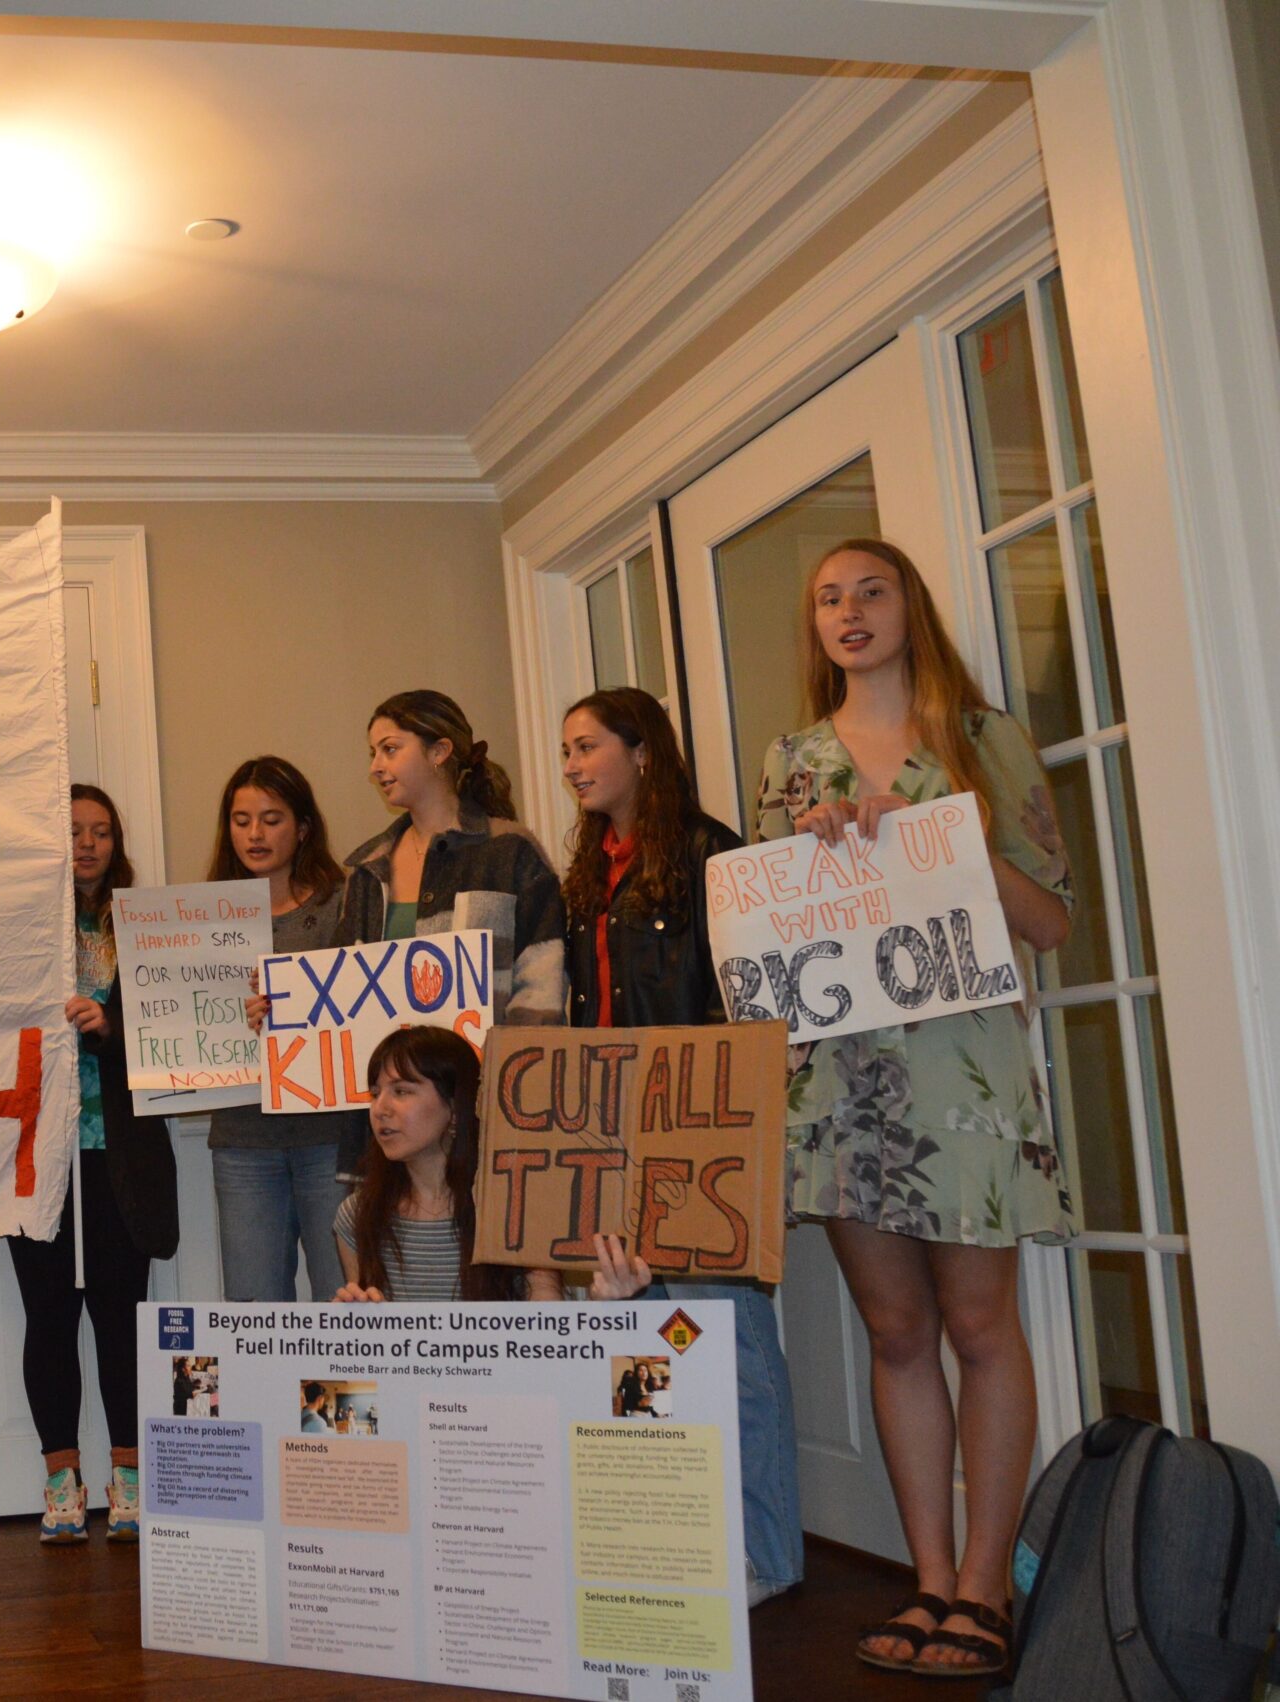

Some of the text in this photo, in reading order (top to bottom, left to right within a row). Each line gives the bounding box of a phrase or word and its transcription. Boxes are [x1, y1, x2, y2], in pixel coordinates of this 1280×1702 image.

[706, 805, 964, 918] BREAK UP
[119, 899, 261, 924] FOSSIL FUEL DIVEST
[770, 887, 892, 944] WITH
[135, 933, 201, 950] HARVARD
[211, 931, 250, 947] SAYS,
[135, 964, 171, 987] OUR
[181, 964, 254, 983] UNIVERSIT
[719, 908, 1018, 1032] BIG OIL
[263, 932, 488, 1031] EXXON
[140, 999, 179, 1018] NEED
[138, 1026, 260, 1068] FREE RESEAR
[498, 1040, 755, 1136] CUT ALL
[492, 1148, 749, 1273] TIES
[208, 1312, 638, 1336] Beyond the Endowment: Uncovering Fossil
[235, 1338, 605, 1364] Fuel Infiltration of Campus Research
[330, 1364, 493, 1378] Phoebe Barr and Becky Schwartz
[428, 1402, 467, 1413] Results
[150, 1424, 245, 1436] What's the problem?
[448, 1423, 456, 1431] at
[457, 1423, 487, 1431] Harvard
[576, 1426, 686, 1440] Recommendations
[285, 1442, 328, 1453] Methods
[151, 1527, 190, 1539] Abstract
[431, 1521, 504, 1533] Chevron at Harvard
[287, 1542, 324, 1554] Results
[288, 1562, 384, 1578] ExxonMobil at Harvard
[369, 1585, 399, 1596] $751,165
[433, 1584, 484, 1595] BP at Harvard
[289, 1602, 328, 1613] $11,171,000
[585, 1592, 686, 1608] Selected References
[583, 1661, 650, 1677] Read More:
[664, 1667, 711, 1682] Join Us:
